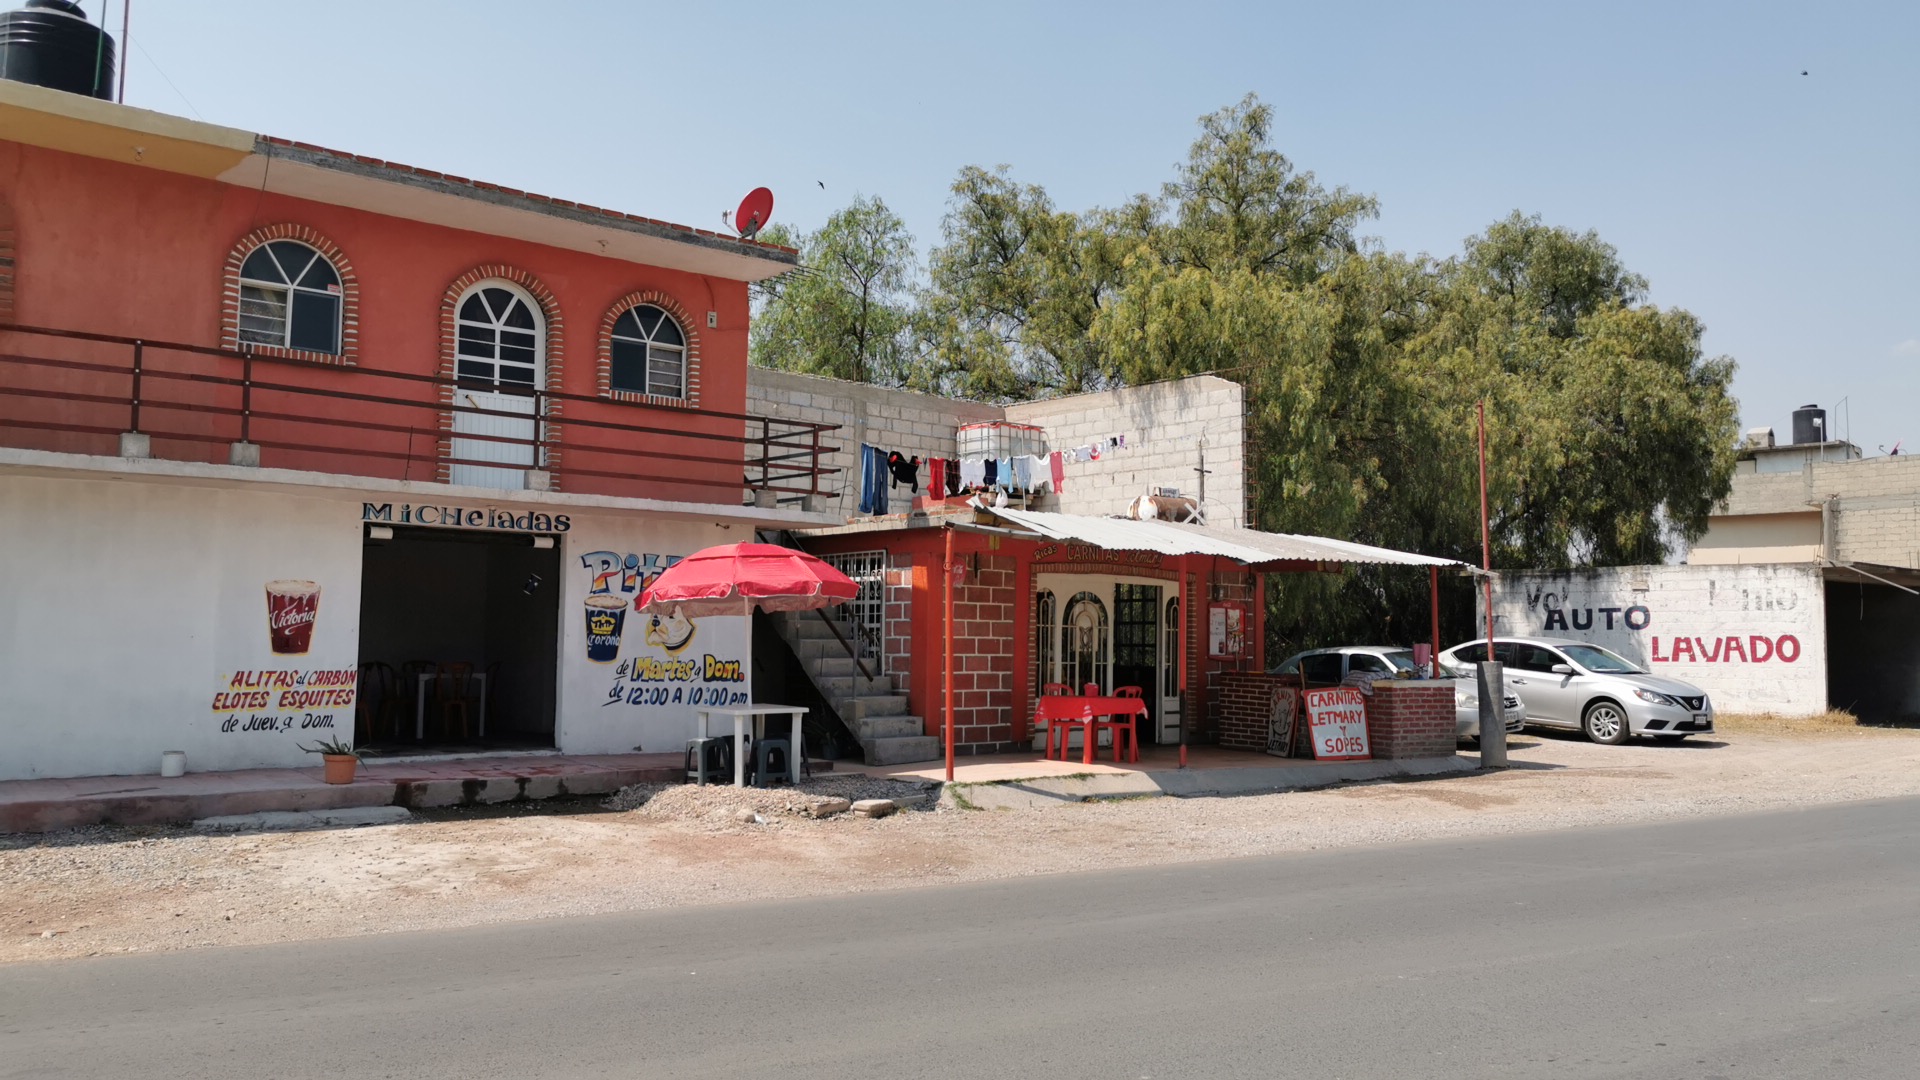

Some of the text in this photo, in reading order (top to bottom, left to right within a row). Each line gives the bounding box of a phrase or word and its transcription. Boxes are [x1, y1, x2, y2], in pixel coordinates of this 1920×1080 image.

[1033, 544, 1058, 561] Ricas
[1066, 544, 1120, 561] CARNITAS
[580, 551, 688, 594] Pit
[270, 601, 315, 635] Victoria
[1544, 605, 1651, 631] AUTO
[1651, 634, 1801, 663] LAVADO
[230, 664, 357, 690] ALITAS al CARBÓN
[616, 659, 629, 680] de
[631, 656, 695, 683] Martes
[703, 654, 745, 683] Dom.
[212, 689, 355, 712] ELOTES ESQUITES
[608, 681, 622, 700] de
[626, 687, 669, 706] 12:00
[672, 687, 683, 704] A
[687, 687, 728, 706] 10:00
[1310, 690, 1364, 708] CARNITAS
[221, 713, 334, 733] de Juev. a Dom.
[1310, 709, 1363, 727] LETMARY
[1338, 725, 1347, 737] Y
[1324, 736, 1364, 754] SOPES
